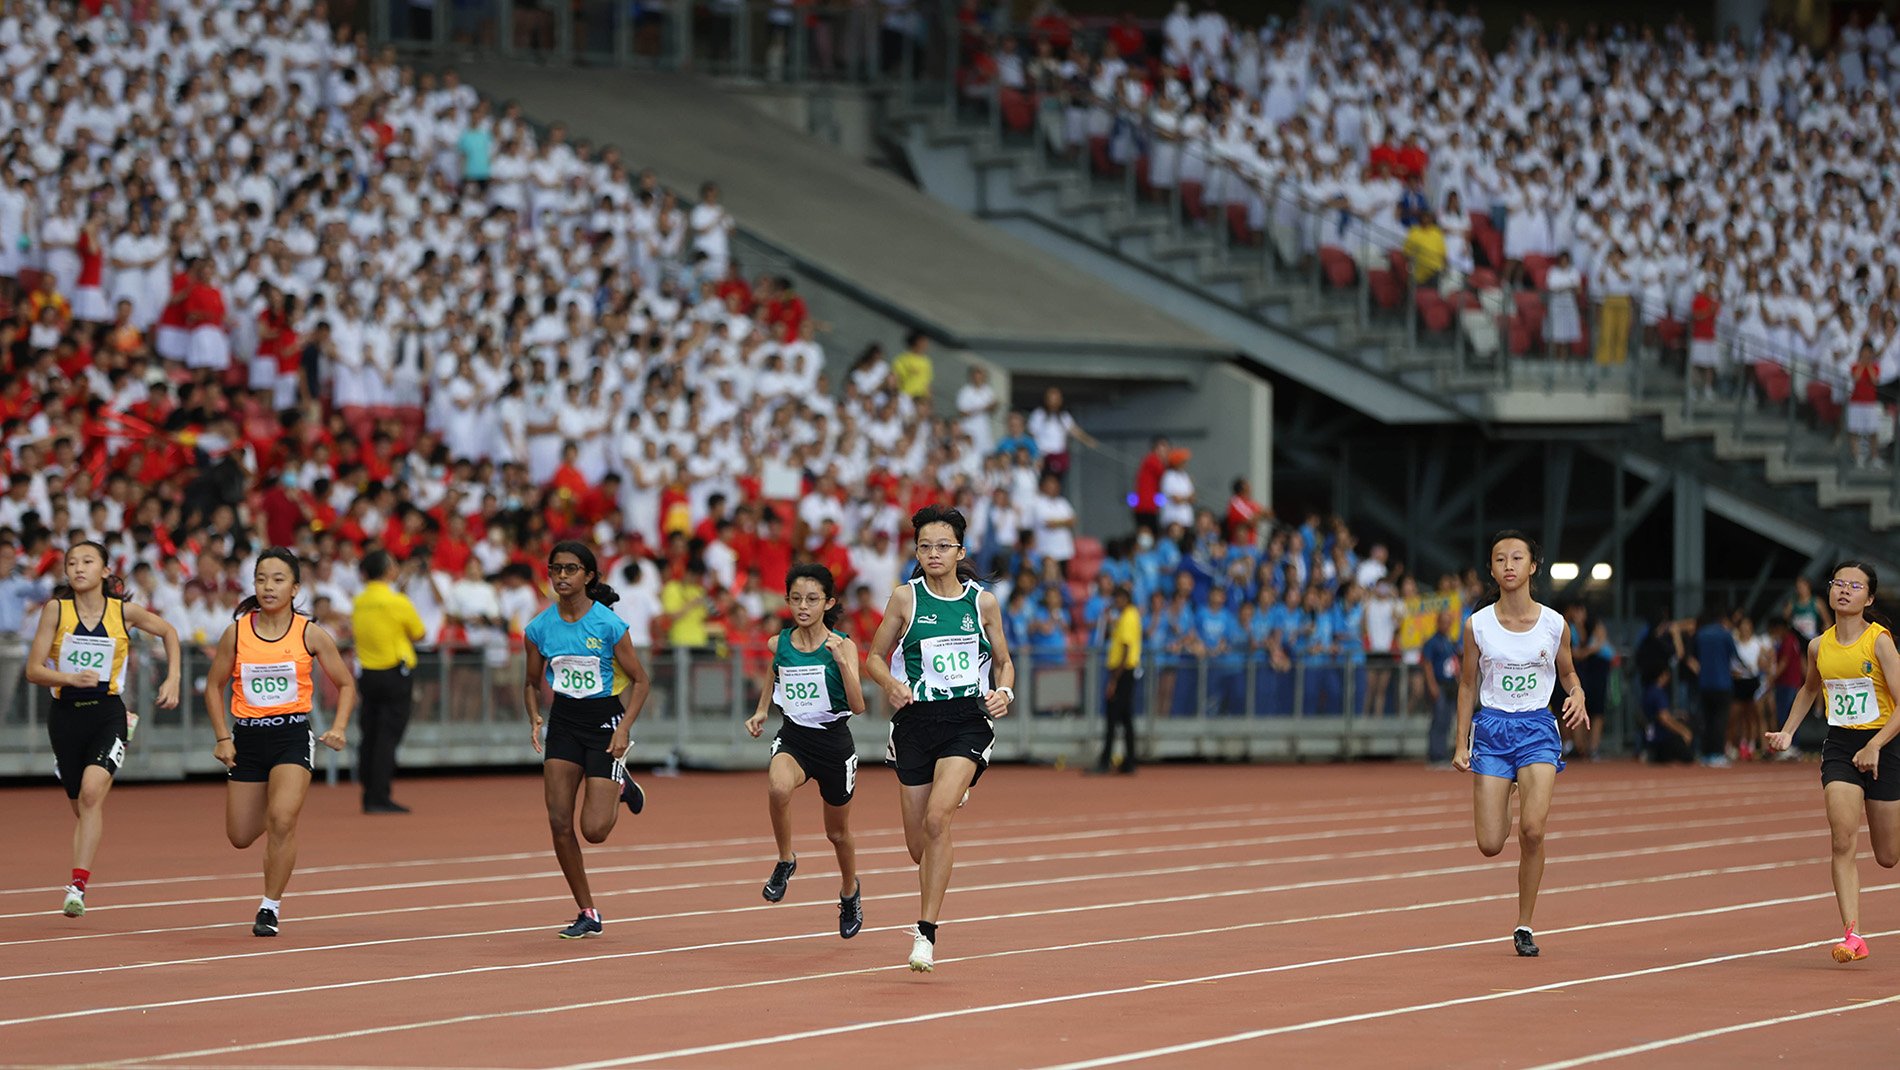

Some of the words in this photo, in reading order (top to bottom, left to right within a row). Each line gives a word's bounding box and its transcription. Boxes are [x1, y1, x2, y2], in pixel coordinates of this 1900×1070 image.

[67, 650, 104, 668] 492
[933, 651, 969, 674] 618
[251, 676, 288, 694] 669
[561, 668, 596, 689] 368
[1502, 673, 1537, 692] 625
[785, 682, 820, 700] 582
[1835, 691, 1868, 716] 327
[250, 716, 285, 727] PRO
